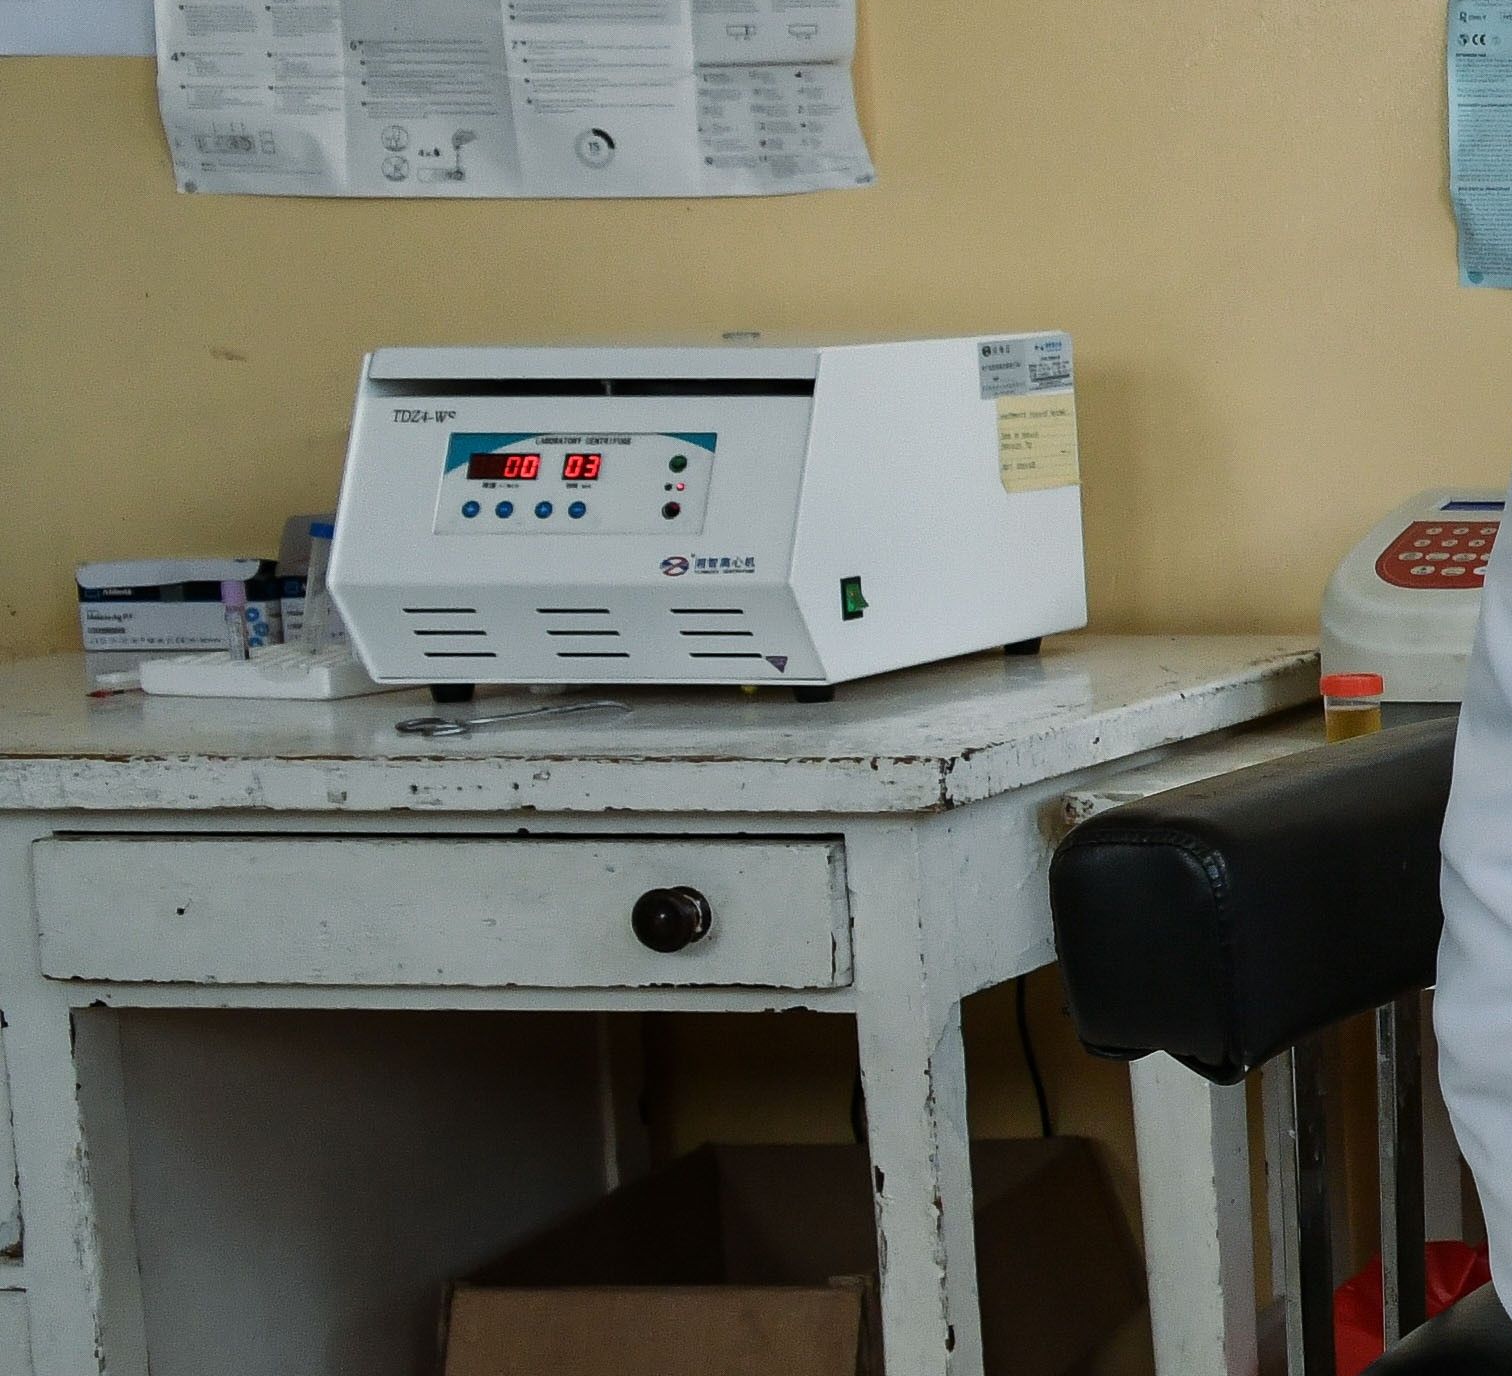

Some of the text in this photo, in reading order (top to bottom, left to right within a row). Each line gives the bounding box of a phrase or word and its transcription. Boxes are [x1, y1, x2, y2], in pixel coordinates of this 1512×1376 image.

[535, 437, 583, 446] LABORATORY
[503, 455, 540, 479] 00
[563, 455, 601, 478] 03
